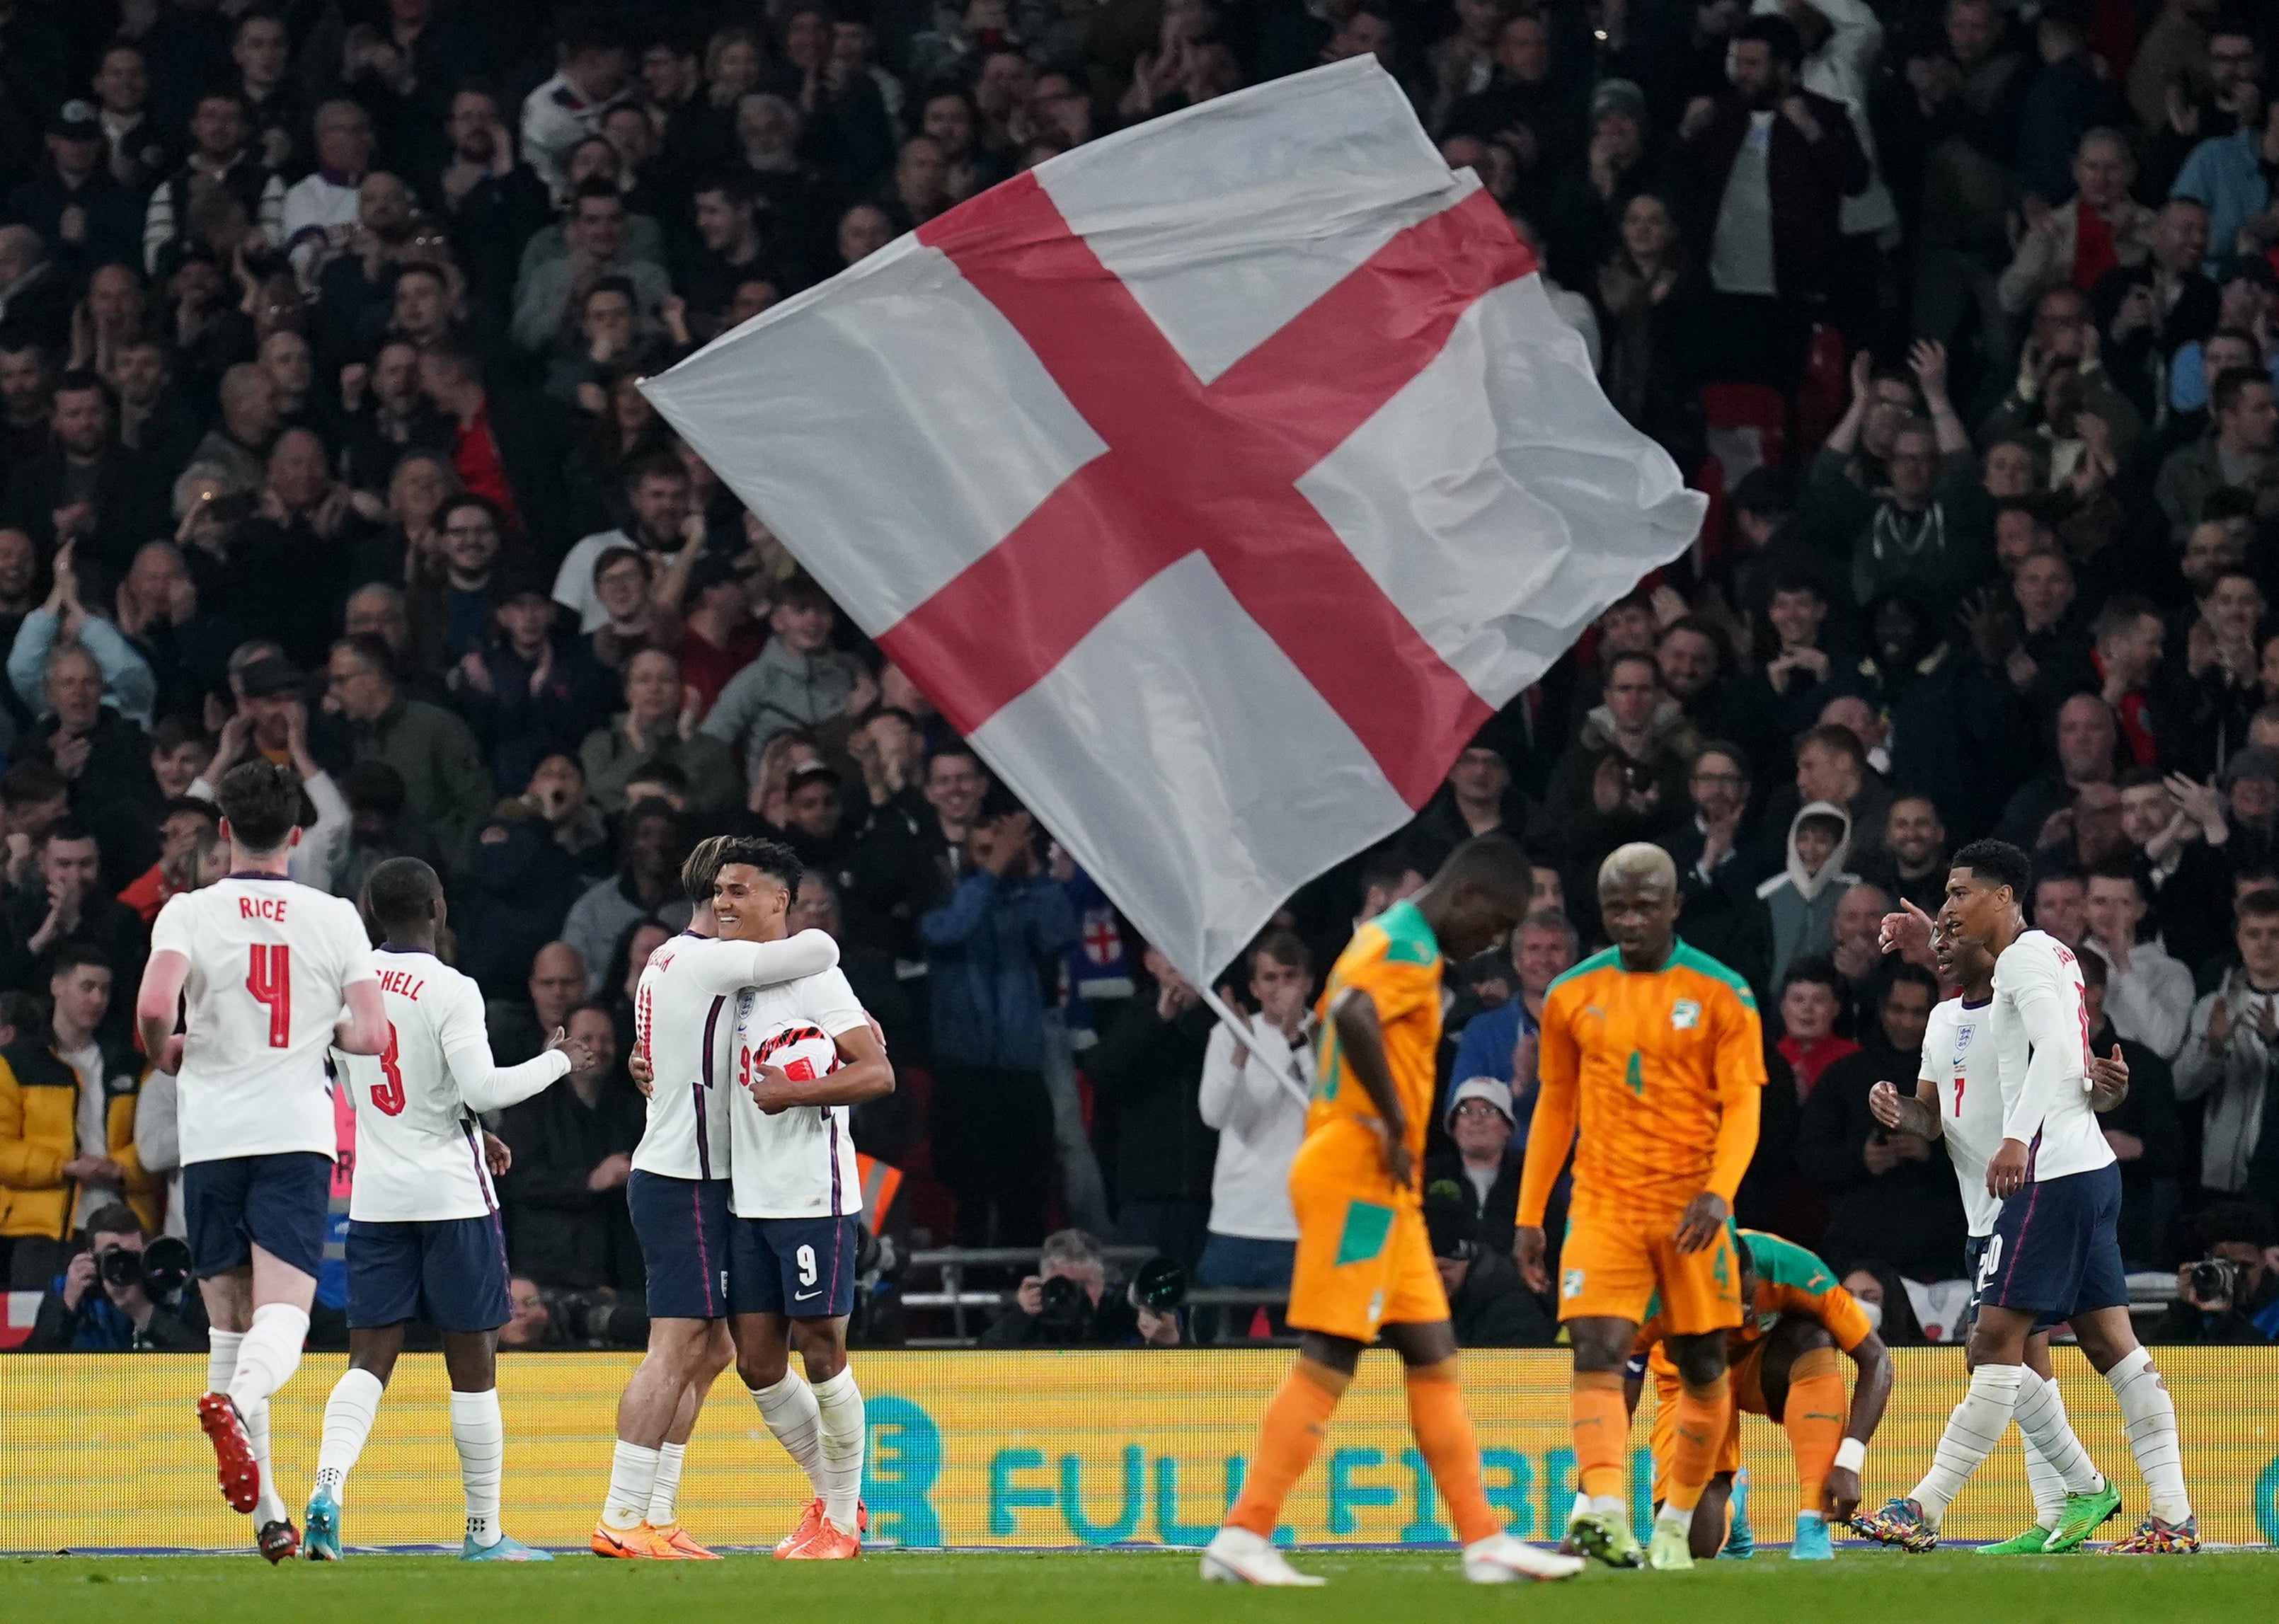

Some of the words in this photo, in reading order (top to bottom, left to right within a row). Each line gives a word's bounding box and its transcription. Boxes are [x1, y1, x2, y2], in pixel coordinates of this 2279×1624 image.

[239, 897, 287, 923] RICE
[246, 943, 290, 1048] 4
[369, 1018, 406, 1117] 3
[739, 1044, 751, 1087] 9
[1625, 1050, 1642, 1095] 4
[1954, 1078, 1965, 1118] 7
[796, 1244, 817, 1287] 9
[1713, 1246, 1728, 1289] 4
[989, 1442, 1295, 1545] FULL
